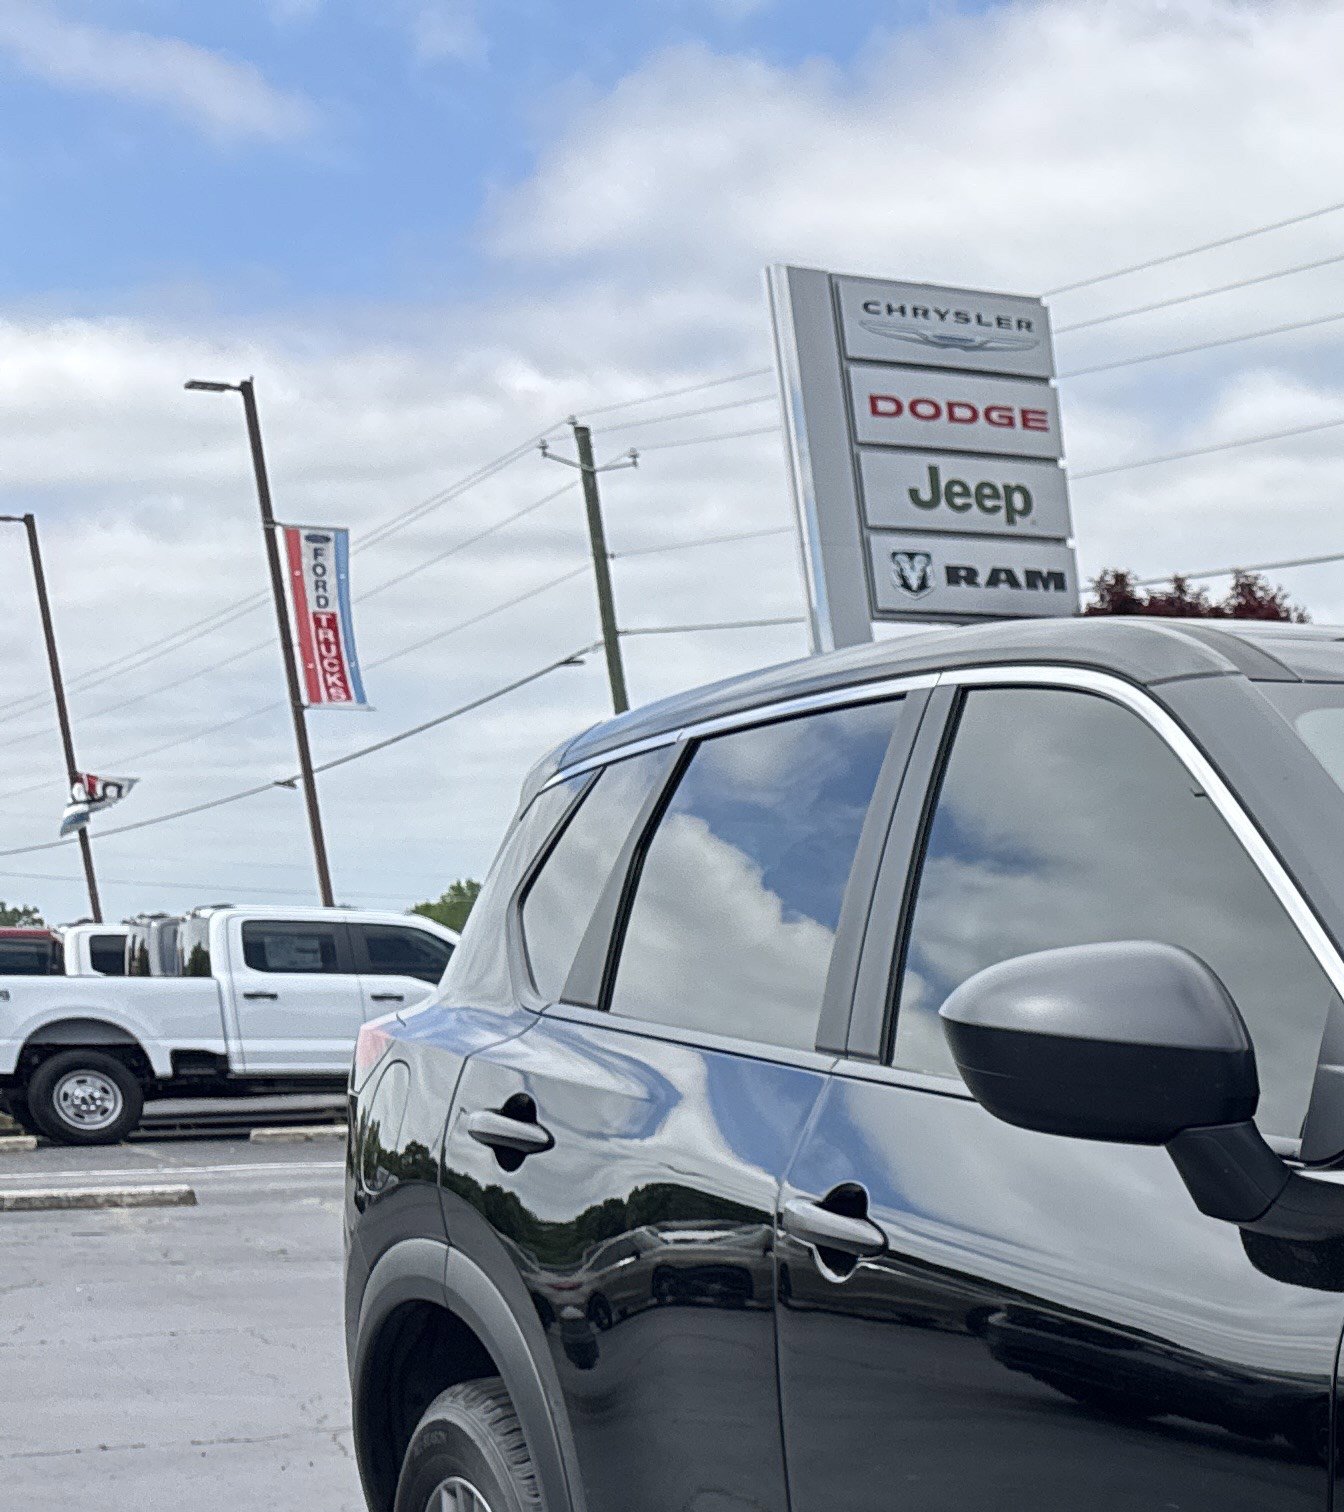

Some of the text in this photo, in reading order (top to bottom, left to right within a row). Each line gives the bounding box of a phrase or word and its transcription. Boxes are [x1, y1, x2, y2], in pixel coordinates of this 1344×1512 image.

[861, 300, 1036, 333] CHRYSLER
[867, 393, 1051, 433] DODGE
[907, 465, 1034, 526] Jeep
[312, 547, 330, 609] FORD
[944, 565, 1069, 592] RAM
[315, 613, 348, 701] TRUCKS
